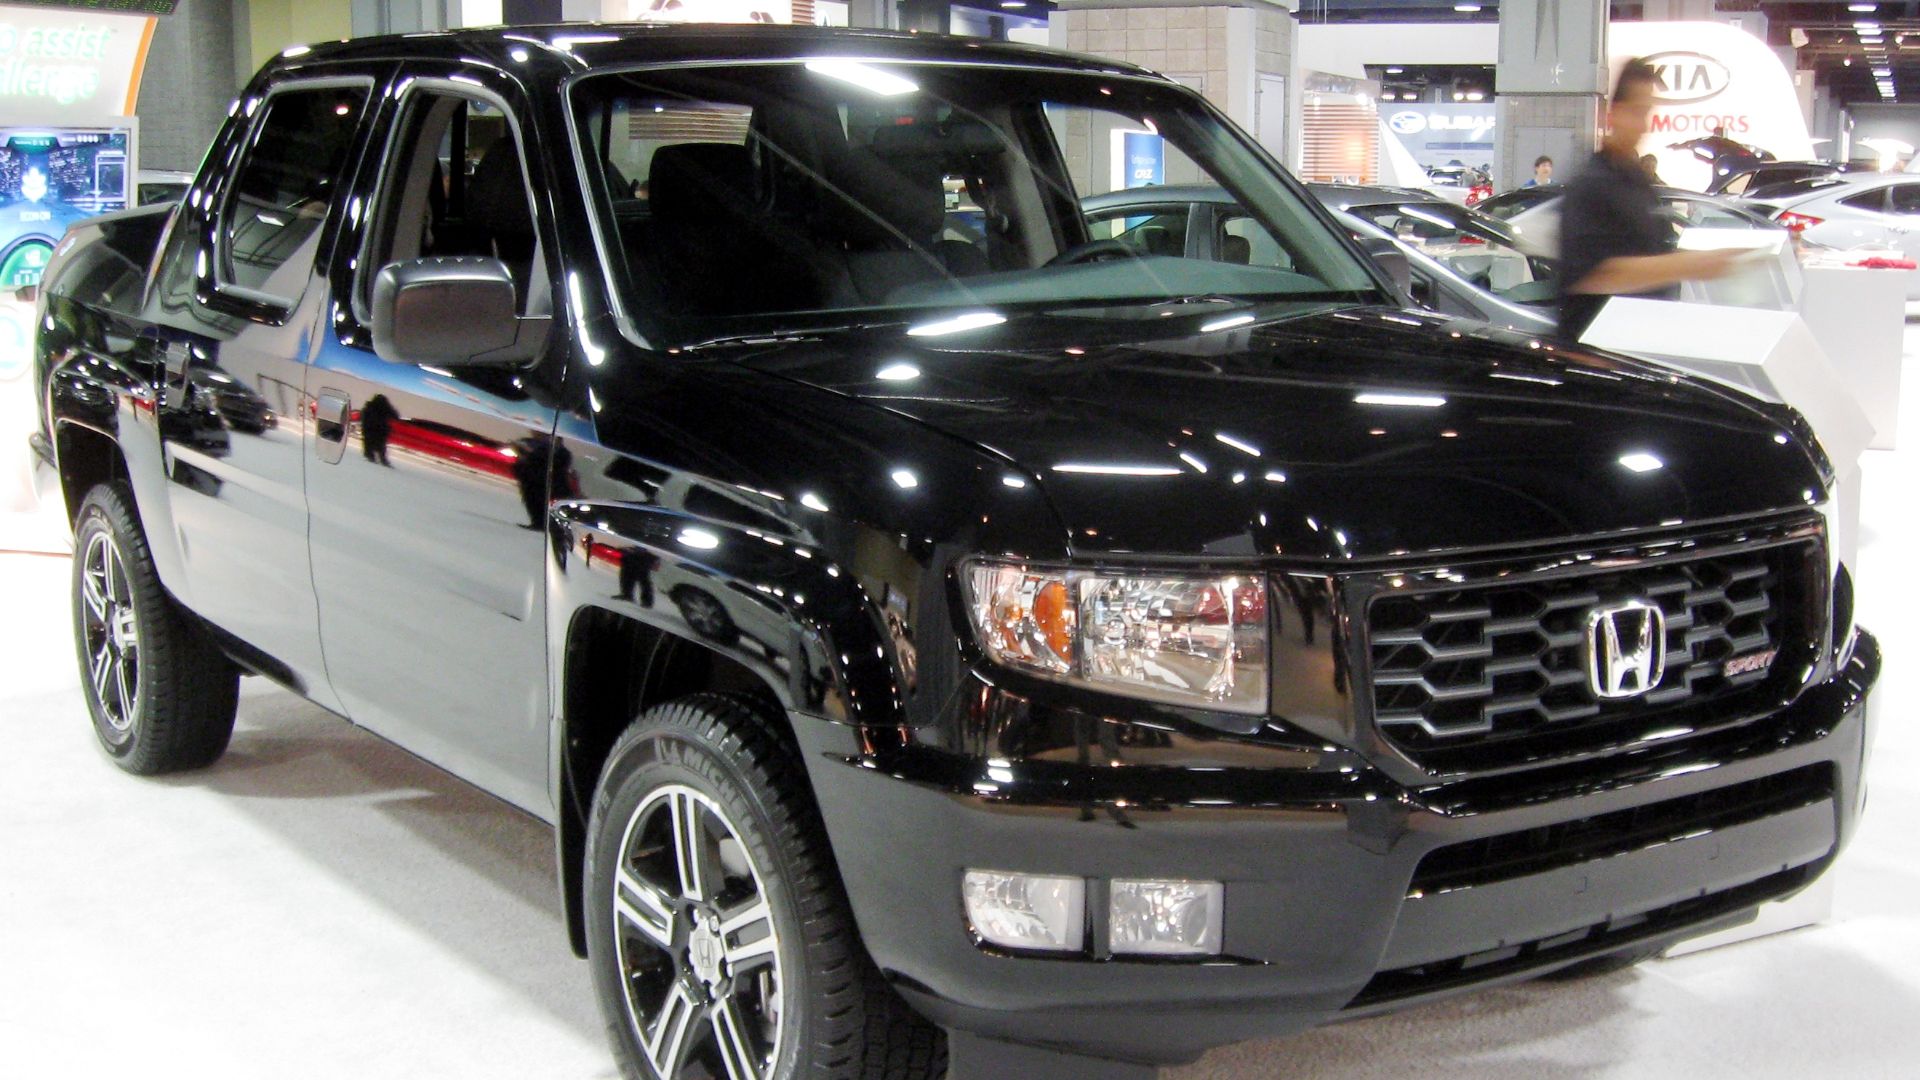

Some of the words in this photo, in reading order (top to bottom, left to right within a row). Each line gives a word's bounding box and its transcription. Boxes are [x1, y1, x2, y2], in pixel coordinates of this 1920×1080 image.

[23, 24, 111, 60] assist
[1646, 64, 1712, 92] KIA
[1650, 114, 1749, 133] MOTORS
[1724, 650, 1777, 677] SPORT
